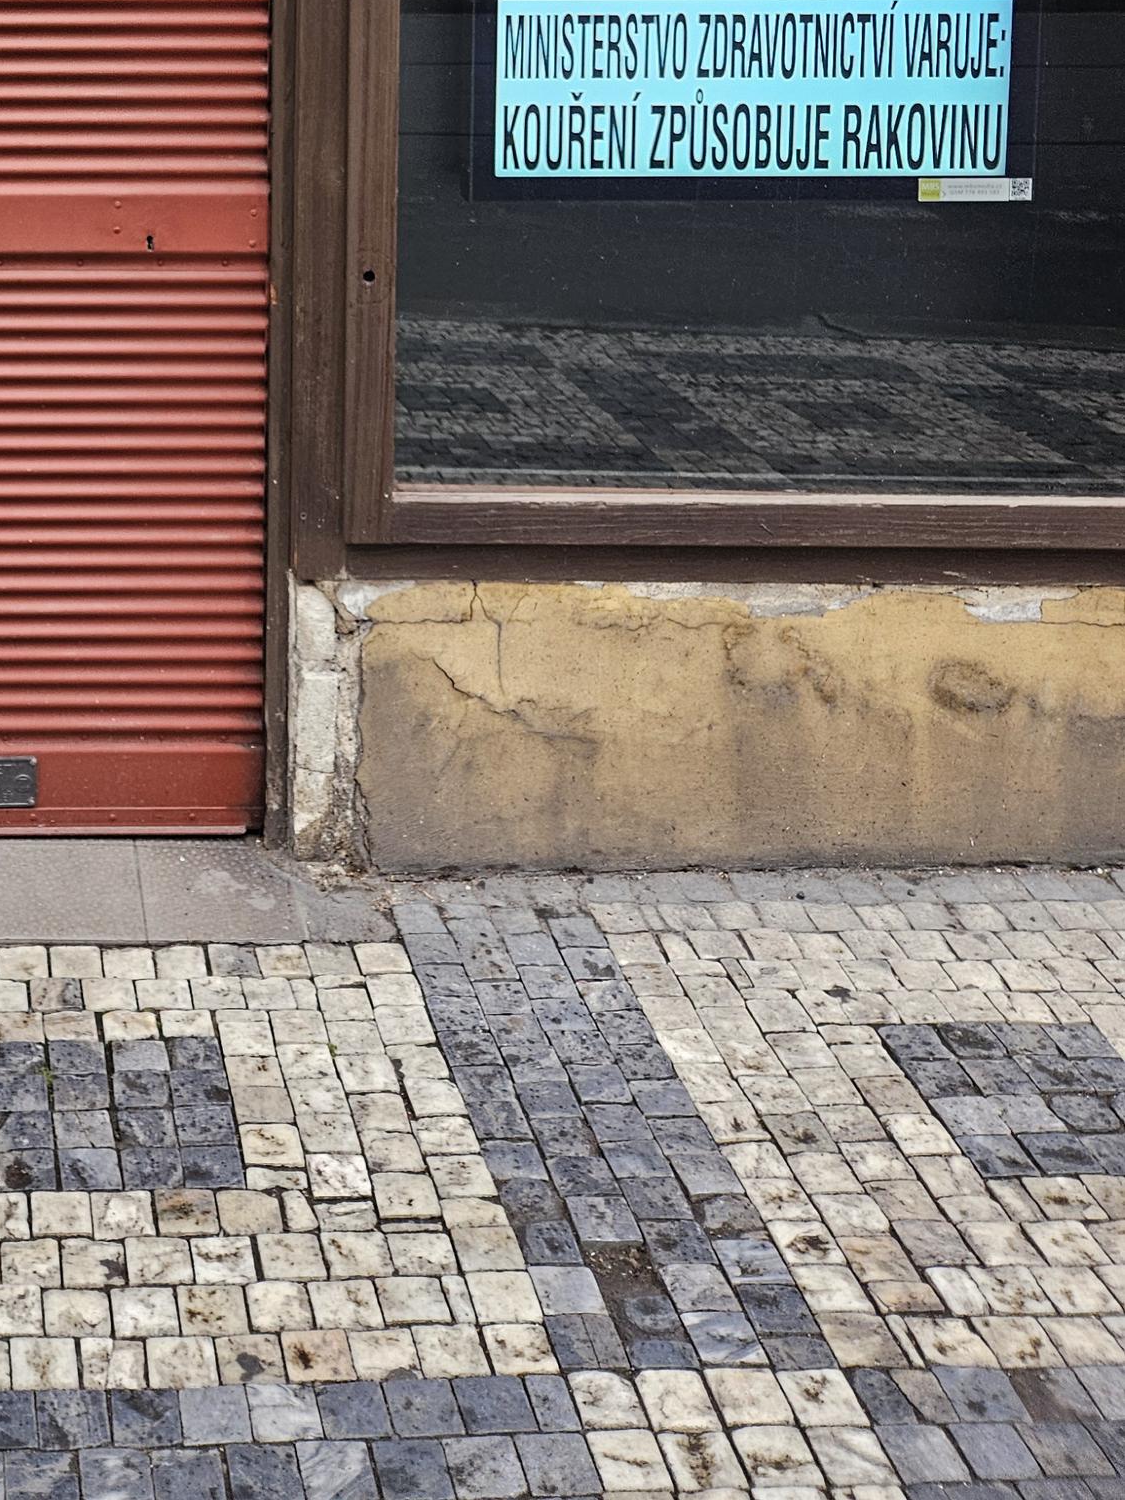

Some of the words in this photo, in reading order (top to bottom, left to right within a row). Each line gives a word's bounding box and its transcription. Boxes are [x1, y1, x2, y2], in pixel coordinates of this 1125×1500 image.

[504, 13, 688, 80] MINISTERSTVO
[696, 0, 898, 79] ZDRAVOTNICTVÍ
[904, 12, 1007, 79] VARUJE:
[503, 92, 641, 171] KOUŘENÍ
[649, 88, 831, 171] ZPŮSOBUJE
[842, 103, 1003, 170] RAKOVINU
